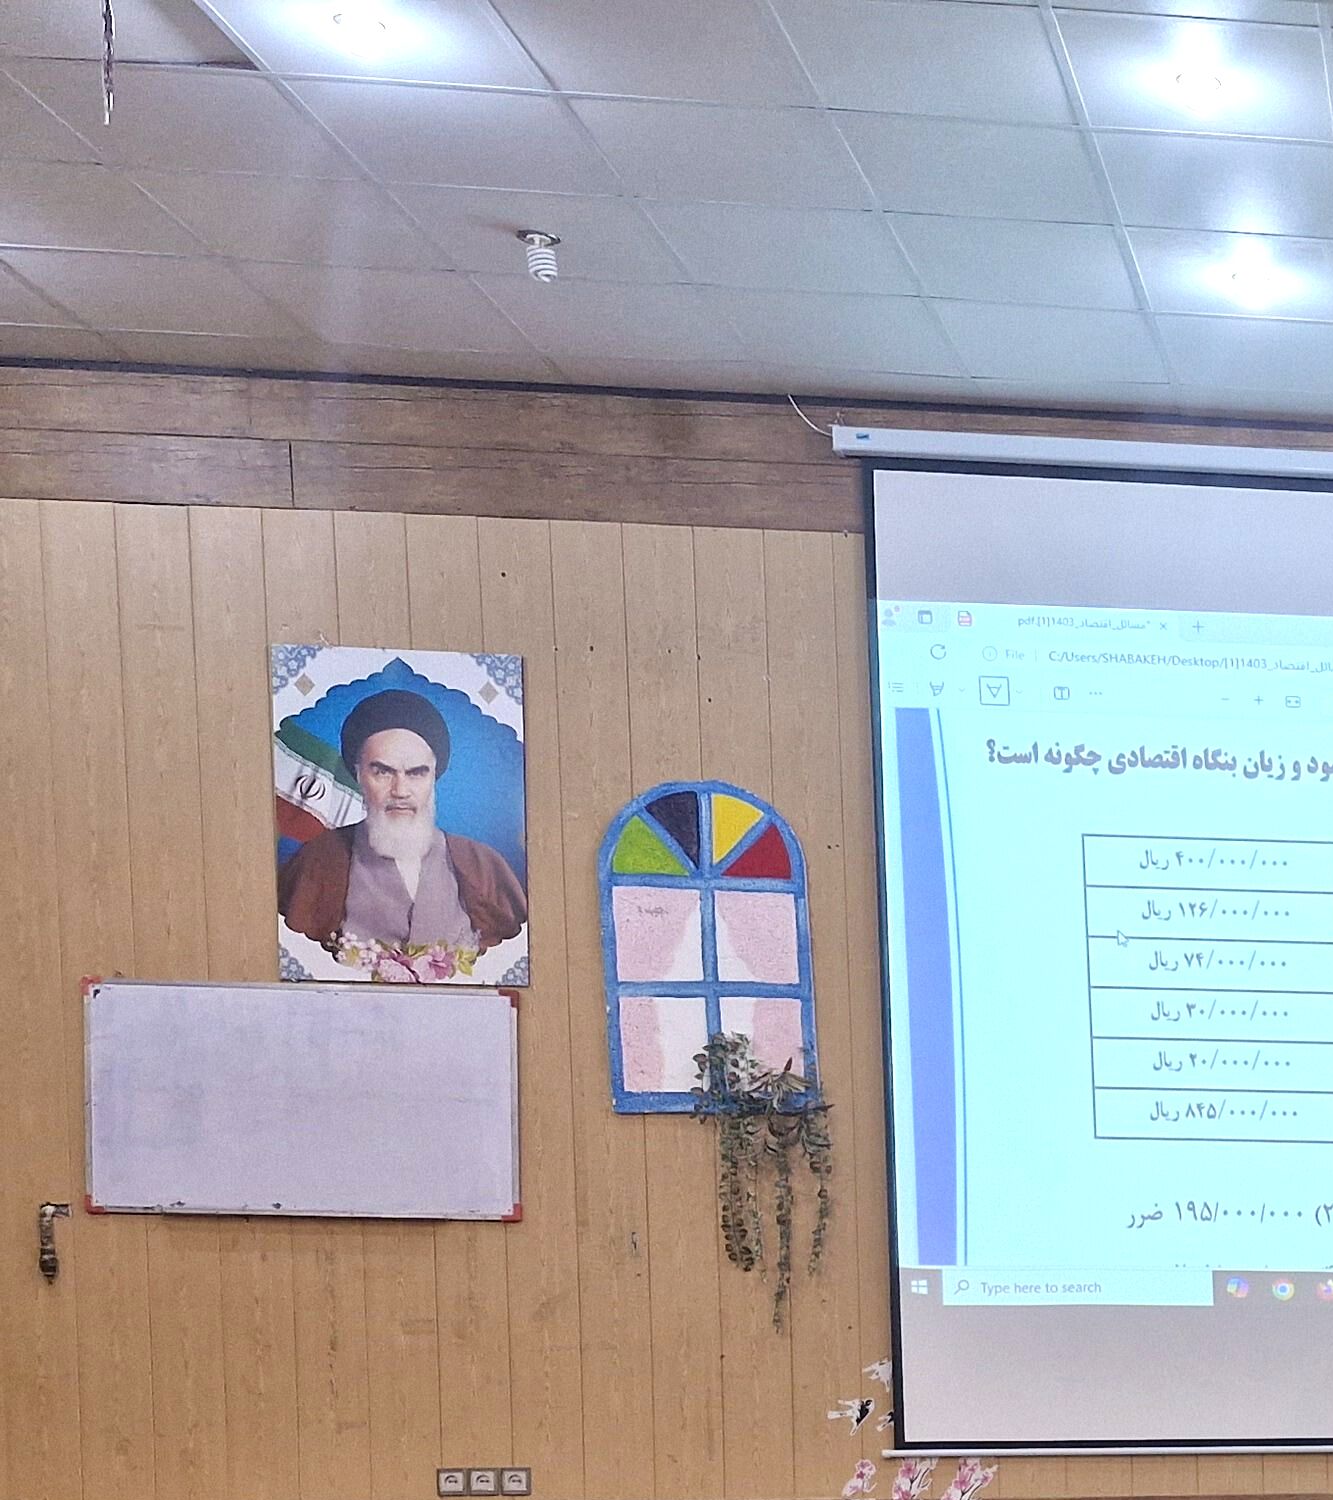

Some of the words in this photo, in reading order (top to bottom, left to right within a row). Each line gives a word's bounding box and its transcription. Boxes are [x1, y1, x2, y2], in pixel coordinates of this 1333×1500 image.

[986, 739, 1038, 764] است؟
[1044, 742, 1102, 775] چگونه
[1108, 745, 1187, 775] اقتصادی
[1192, 747, 1237, 778] بنگاه
[1243, 750, 1285, 780] زیان
[1291, 760, 1301, 781] و
[1140, 849, 1169, 870] ریال
[1175, 848, 1287, 870] ۴۰۰/۰۰۰/۰۰۰
[1142, 900, 1171, 921] ریال
[1179, 899, 1289, 920] ۱۲۶/۰۰۰/۰۰۰
[1149, 951, 1179, 971] ریال
[1184, 949, 1286, 970] ۷۴/۰۰۰/۰۰۰
[1151, 1001, 1180, 1022] ریال
[1186, 999, 1288, 1021] ۳۰/۰۰۰/۰۰۰
[1153, 1051, 1183, 1072] ریال
[1189, 1049, 1290, 1070] ۲۰/۰۰۰/۰۰۰
[1150, 1101, 1179, 1122] ریال
[1185, 1099, 1297, 1120] ۸۴۵/۰۰۰/۰۰۰
[1127, 1203, 1163, 1228] ضرر
[980, 1282, 1010, 1298] Type
[1014, 1283, 1041, 1296] here
[1045, 1283, 1058, 1293] to
[1062, 1282, 1101, 1295] search
